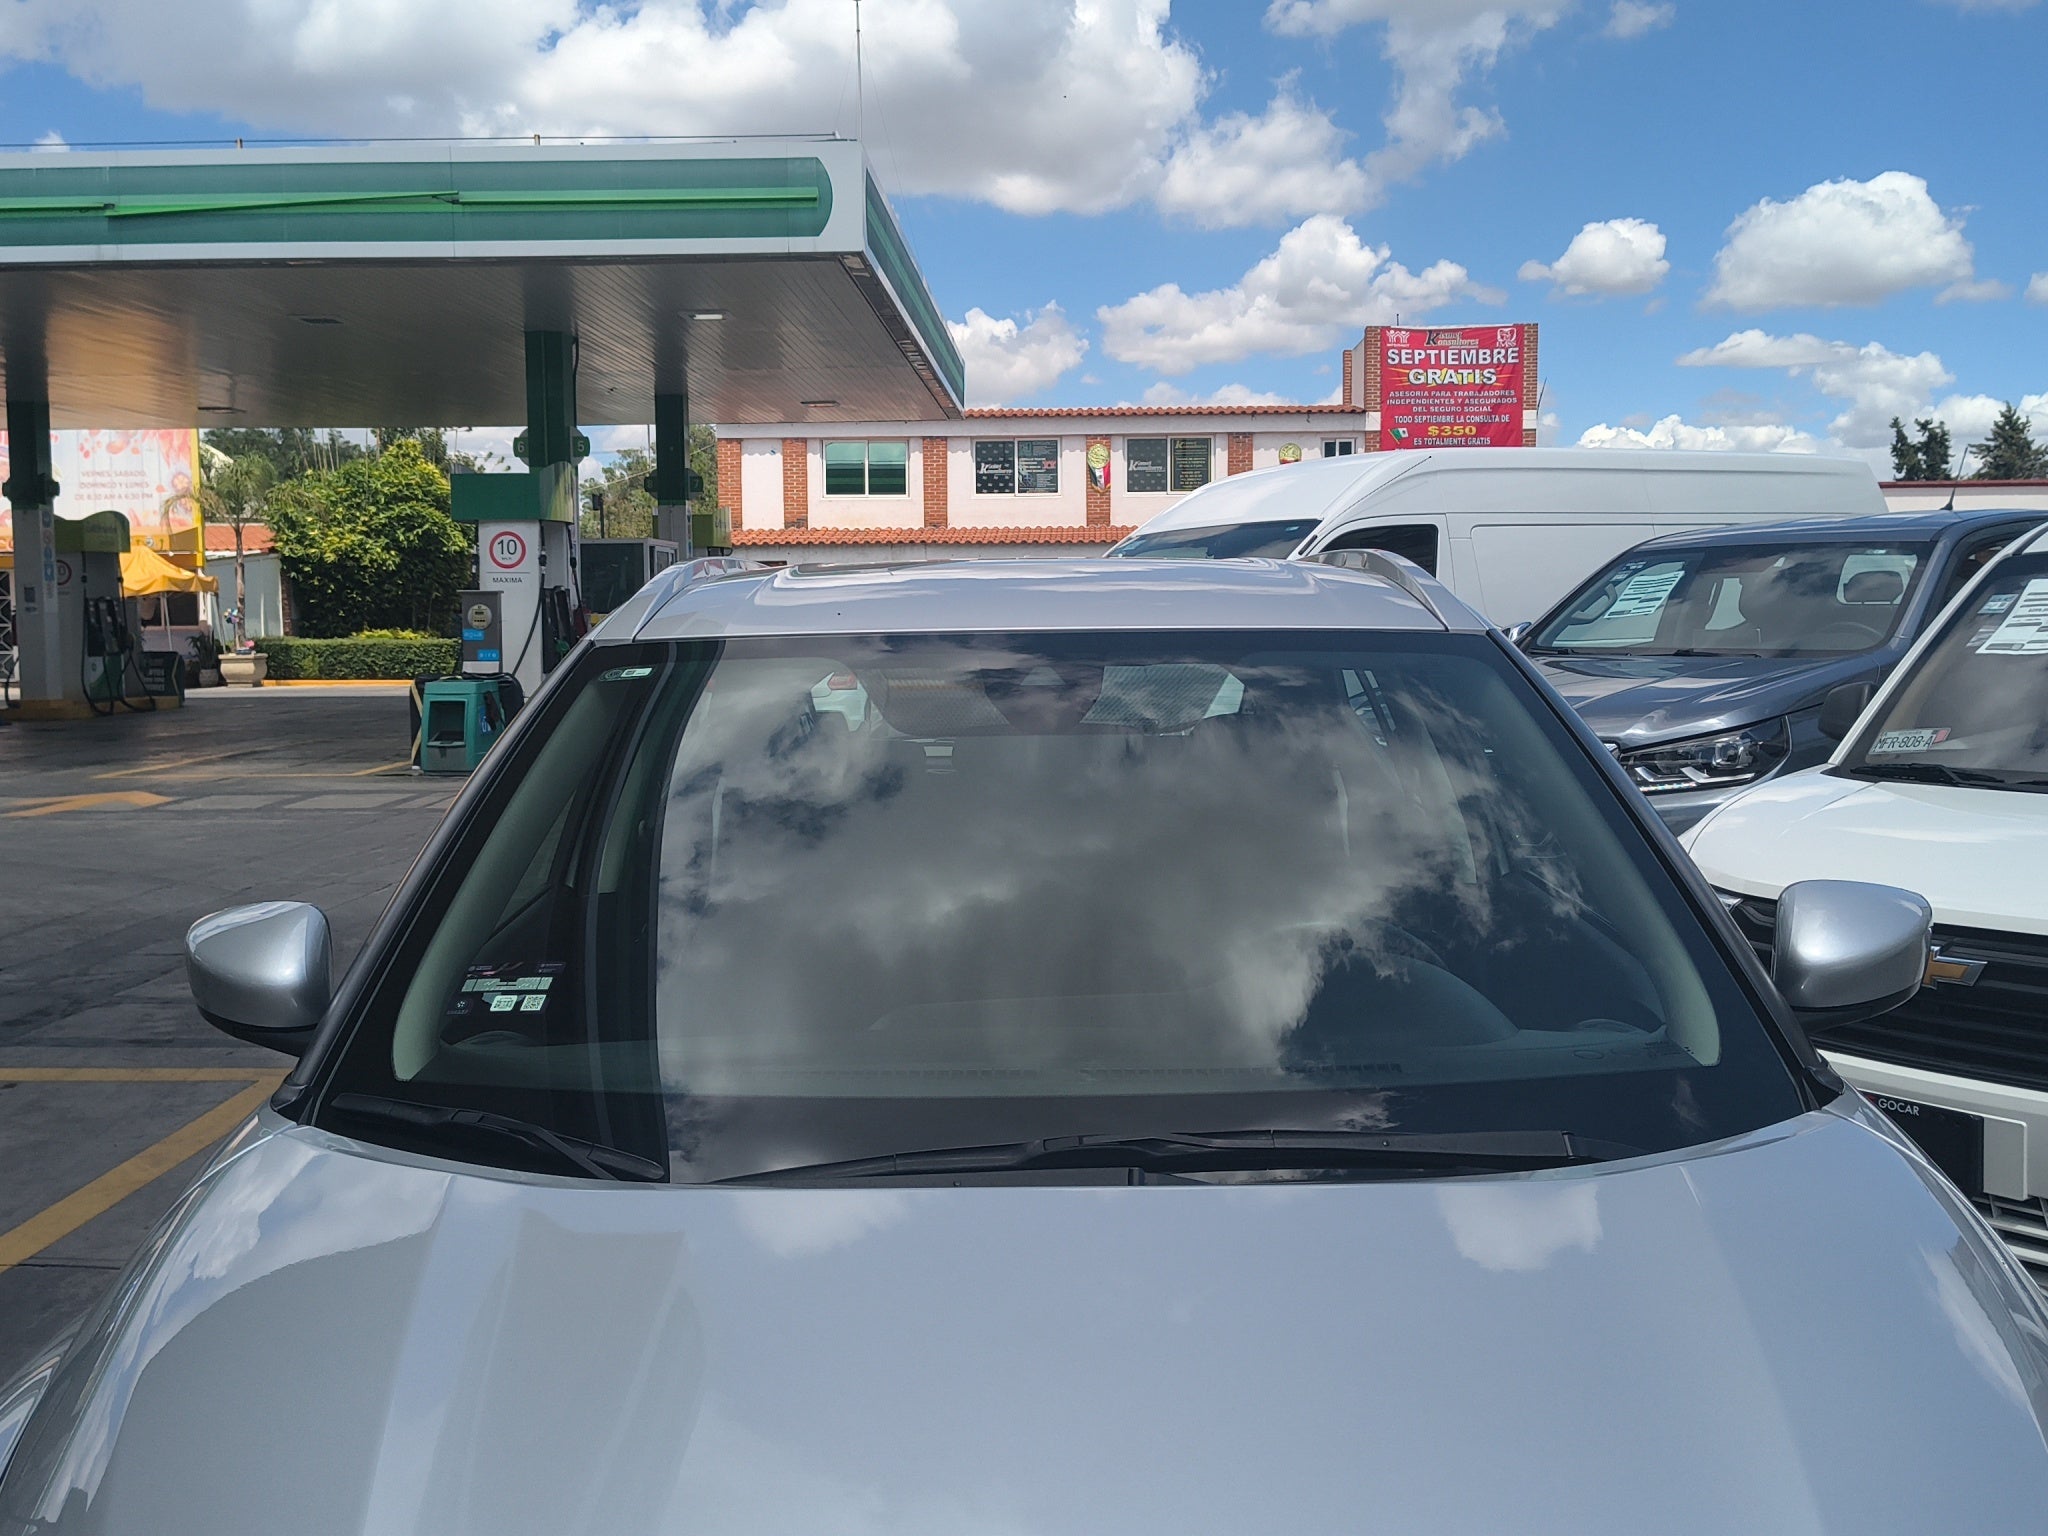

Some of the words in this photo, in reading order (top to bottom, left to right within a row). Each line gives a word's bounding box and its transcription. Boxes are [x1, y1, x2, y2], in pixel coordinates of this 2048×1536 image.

[1387, 347, 1519, 365] SEPTIEMBRE
[1408, 368, 1497, 385] GRATIS
[1454, 389, 1515, 397] TRABAJADORES
[1394, 415, 1412, 423] TODO
[1414, 415, 1454, 423] SEPTIEMBRE
[1466, 414, 1499, 423] CONSULTA
[1501, 414, 1510, 422] DE
[1428, 425, 1477, 436] $350
[517, 442, 525, 452] 6
[577, 440, 585, 451] 5
[1413, 437, 1422, 446] ES
[1424, 437, 1466, 445] TOTALMENTE
[1468, 437, 1491, 445] GRATIS
[497, 539, 517, 555] 10
[1878, 1098, 1920, 1116] GOCAR
